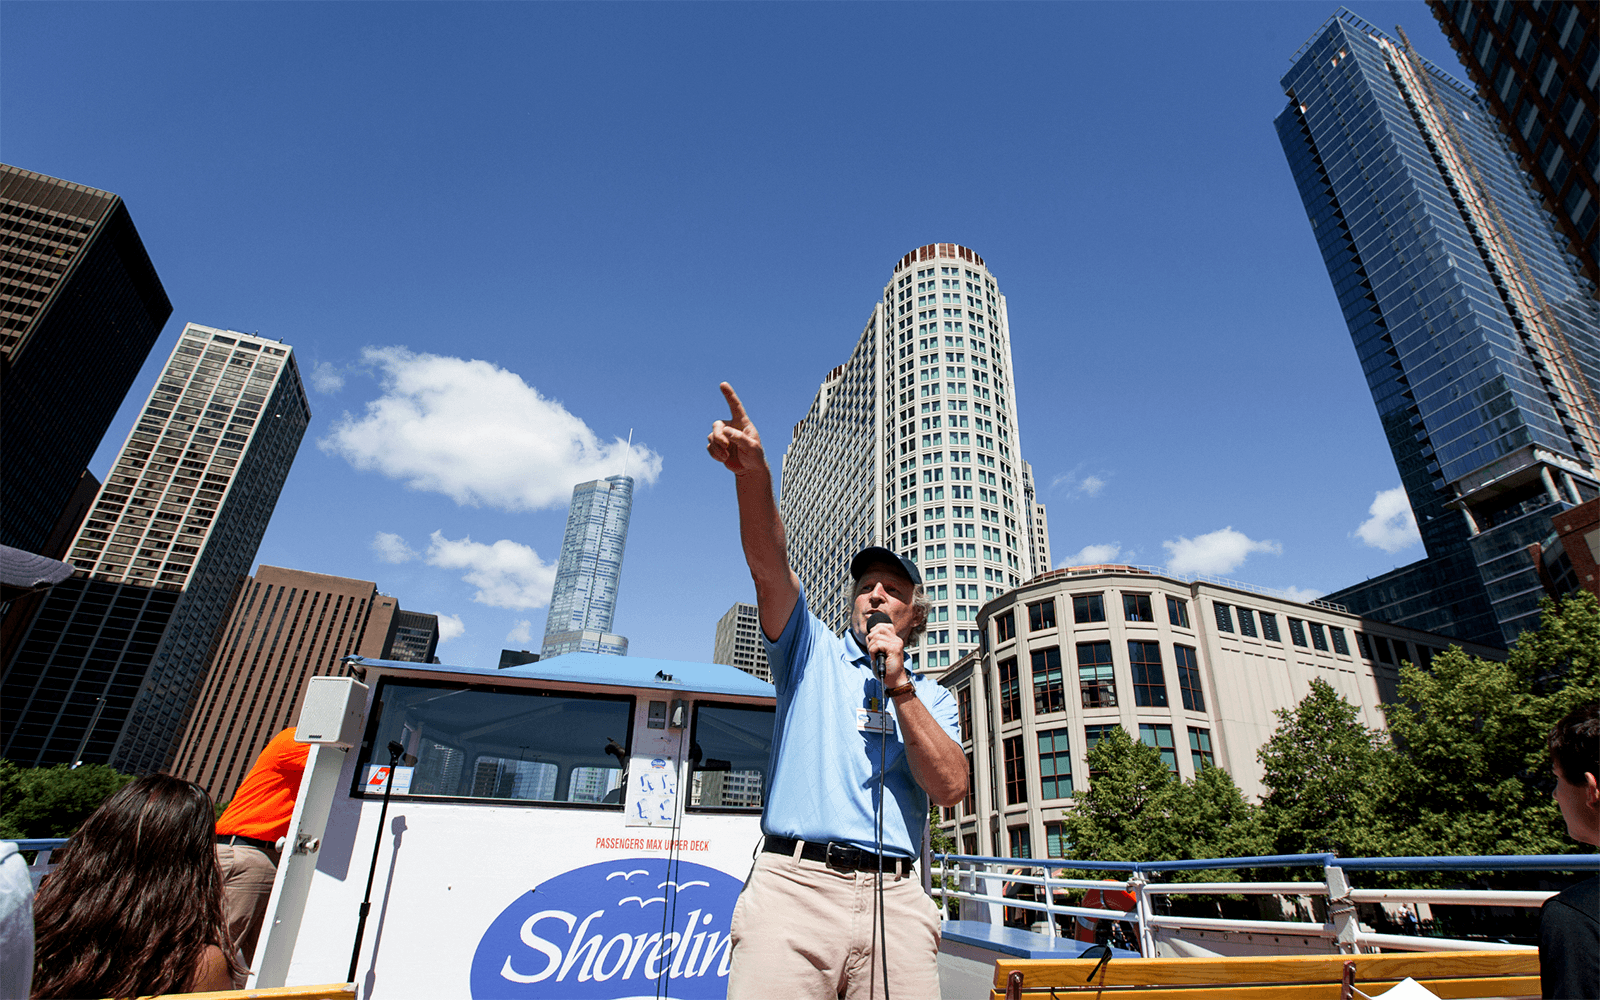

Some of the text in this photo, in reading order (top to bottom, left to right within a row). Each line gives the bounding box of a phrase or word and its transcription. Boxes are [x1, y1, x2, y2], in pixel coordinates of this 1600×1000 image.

[596, 837, 645, 850] PASSENGERS
[646, 839, 663, 850] MAX
[690, 840, 710, 852] DECK
[500, 909, 731, 983] Shorelin
